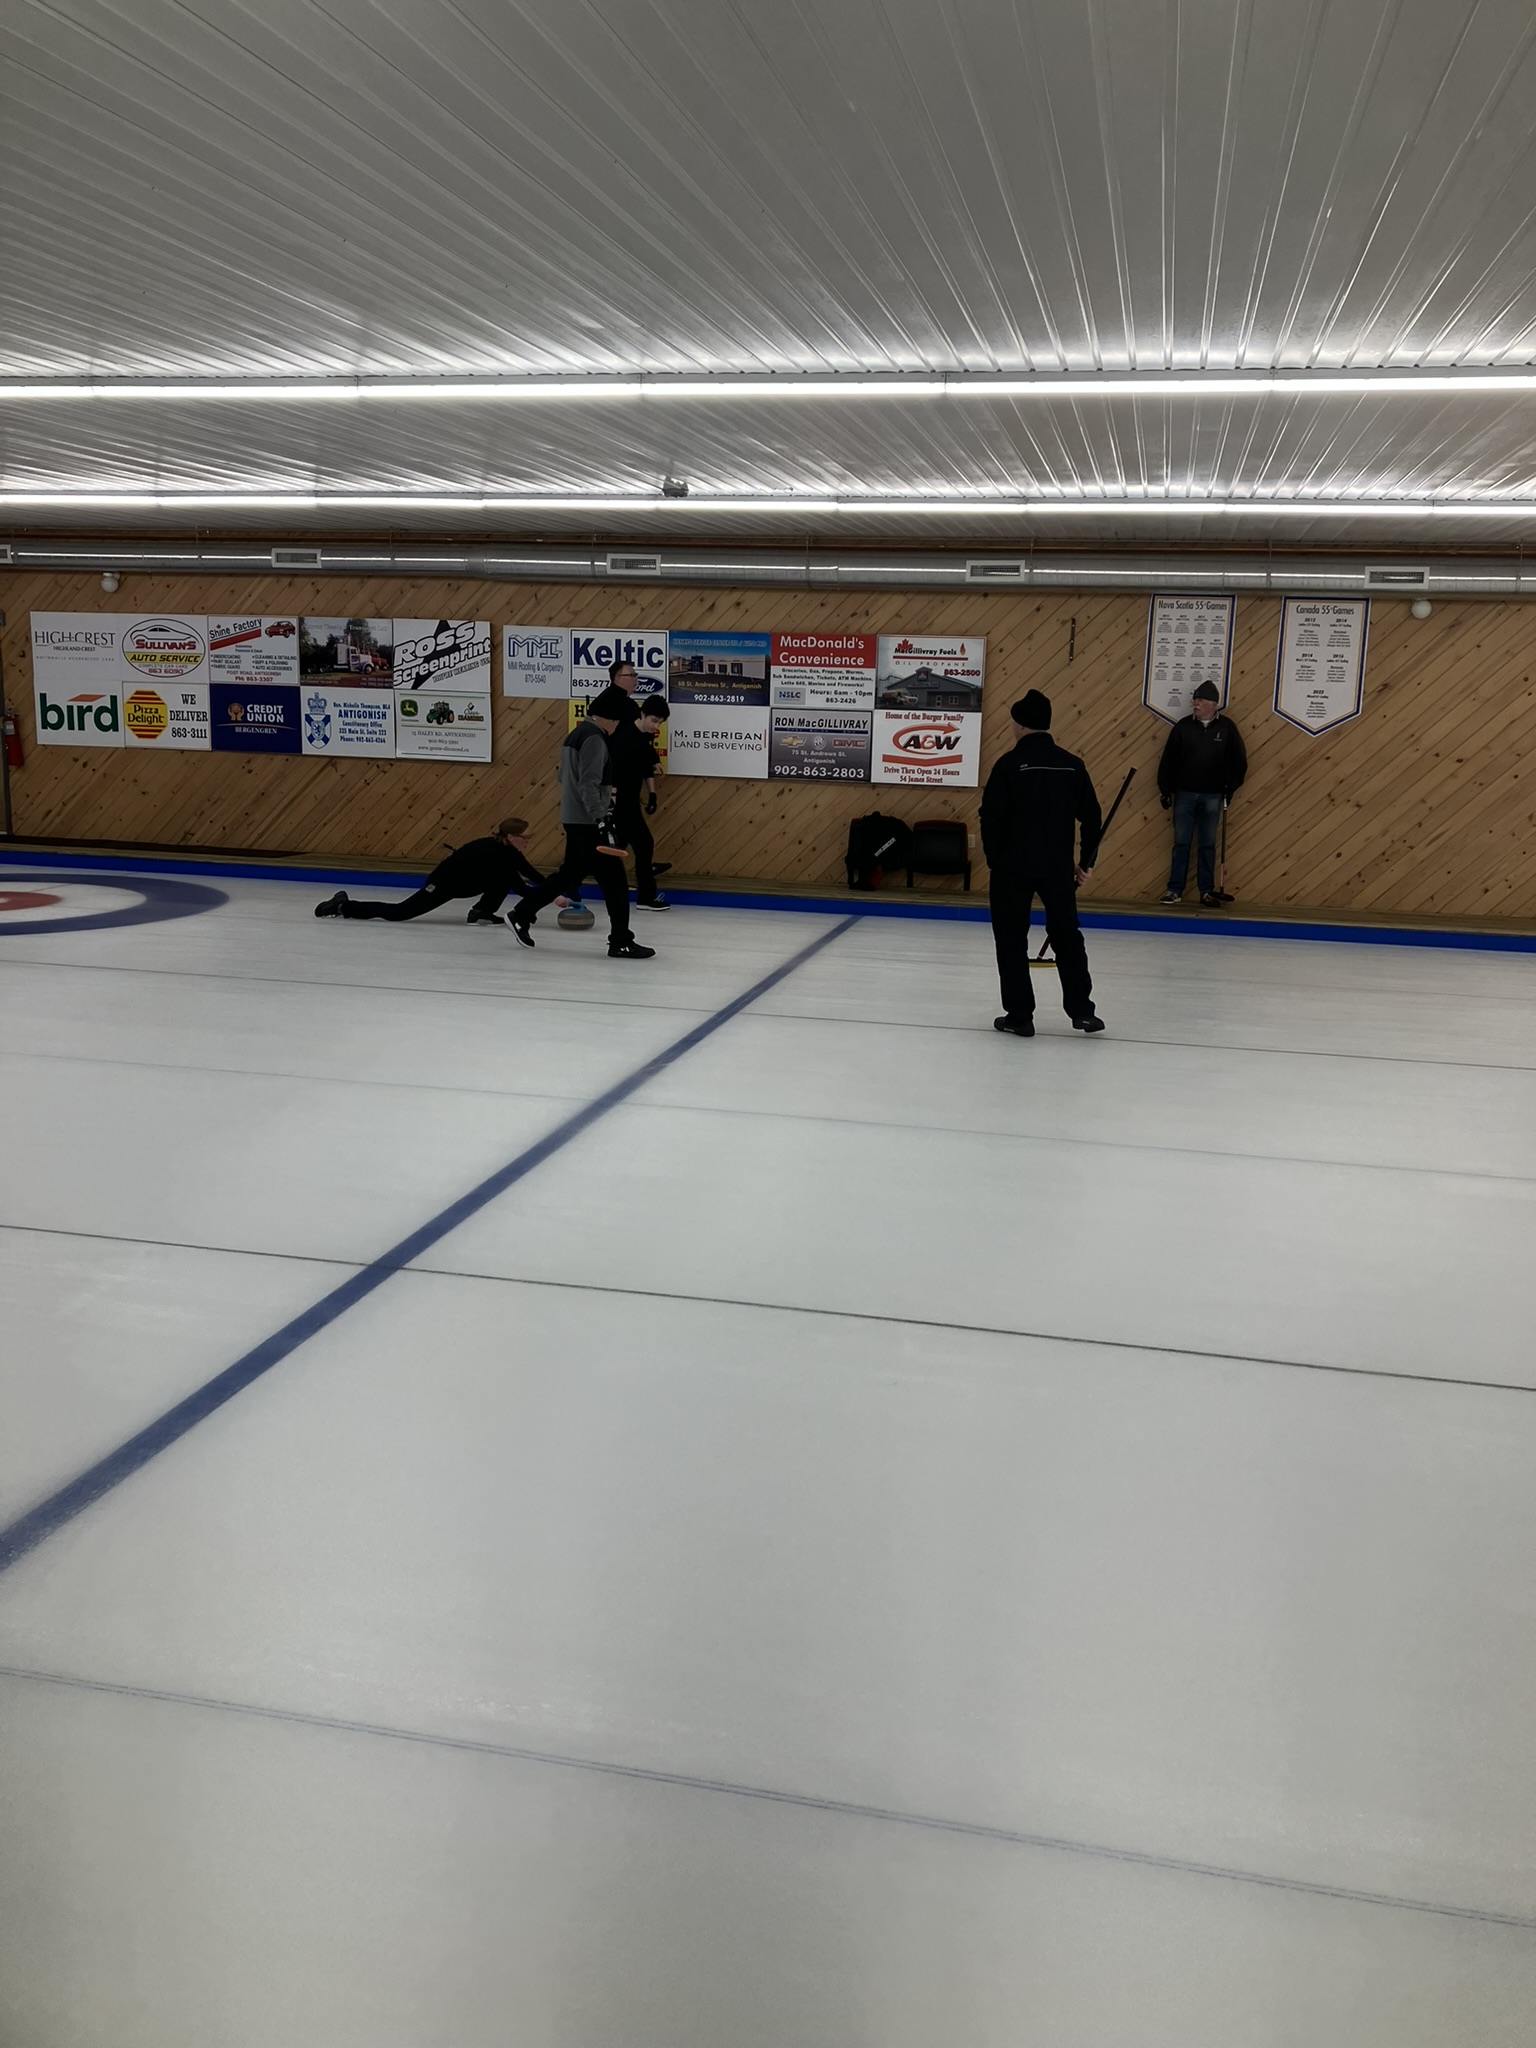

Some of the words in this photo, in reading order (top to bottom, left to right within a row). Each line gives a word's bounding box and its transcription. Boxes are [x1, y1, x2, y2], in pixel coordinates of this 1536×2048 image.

[1158, 600, 1174, 609] Nova
[1176, 601, 1194, 609] Scotia
[1206, 601, 1227, 610] Games
[1296, 605, 1320, 614] Canada
[1333, 606, 1354, 615] Games
[210, 628, 230, 638] Shine
[233, 619, 261, 632] Factory
[780, 636, 864, 649] MacDonald's
[573, 637, 664, 668] Keltic
[780, 652, 864, 665] Convenience
[519, 662, 536, 673] Roofing
[541, 662, 564, 674] Carpentry
[572, 679, 610, 688] 863-277
[181, 694, 196, 705] WE
[694, 694, 744, 702] 902-863-2819
[40, 693, 119, 732] bird
[134, 704, 159, 714] Pizza
[247, 704, 283, 714] CREDIT
[338, 709, 387, 720] ANTIGONISH
[128, 713, 165, 724] Delight
[169, 710, 208, 722] DELIVER
[247, 713, 284, 723] UNION
[922, 713, 942, 722] Burger
[943, 714, 964, 723] Family
[775, 717, 795, 726] RON
[797, 718, 868, 729] MacGILLIVRAY
[171, 727, 207, 738] 863-3111
[693, 730, 762, 740] BERRIGAN
[704, 742, 762, 751] SURVEYING
[833, 738, 866, 749] GMC
[902, 734, 961, 750] A&W
[774, 765, 864, 778] 902-863-2803
[916, 768, 932, 776] Open
